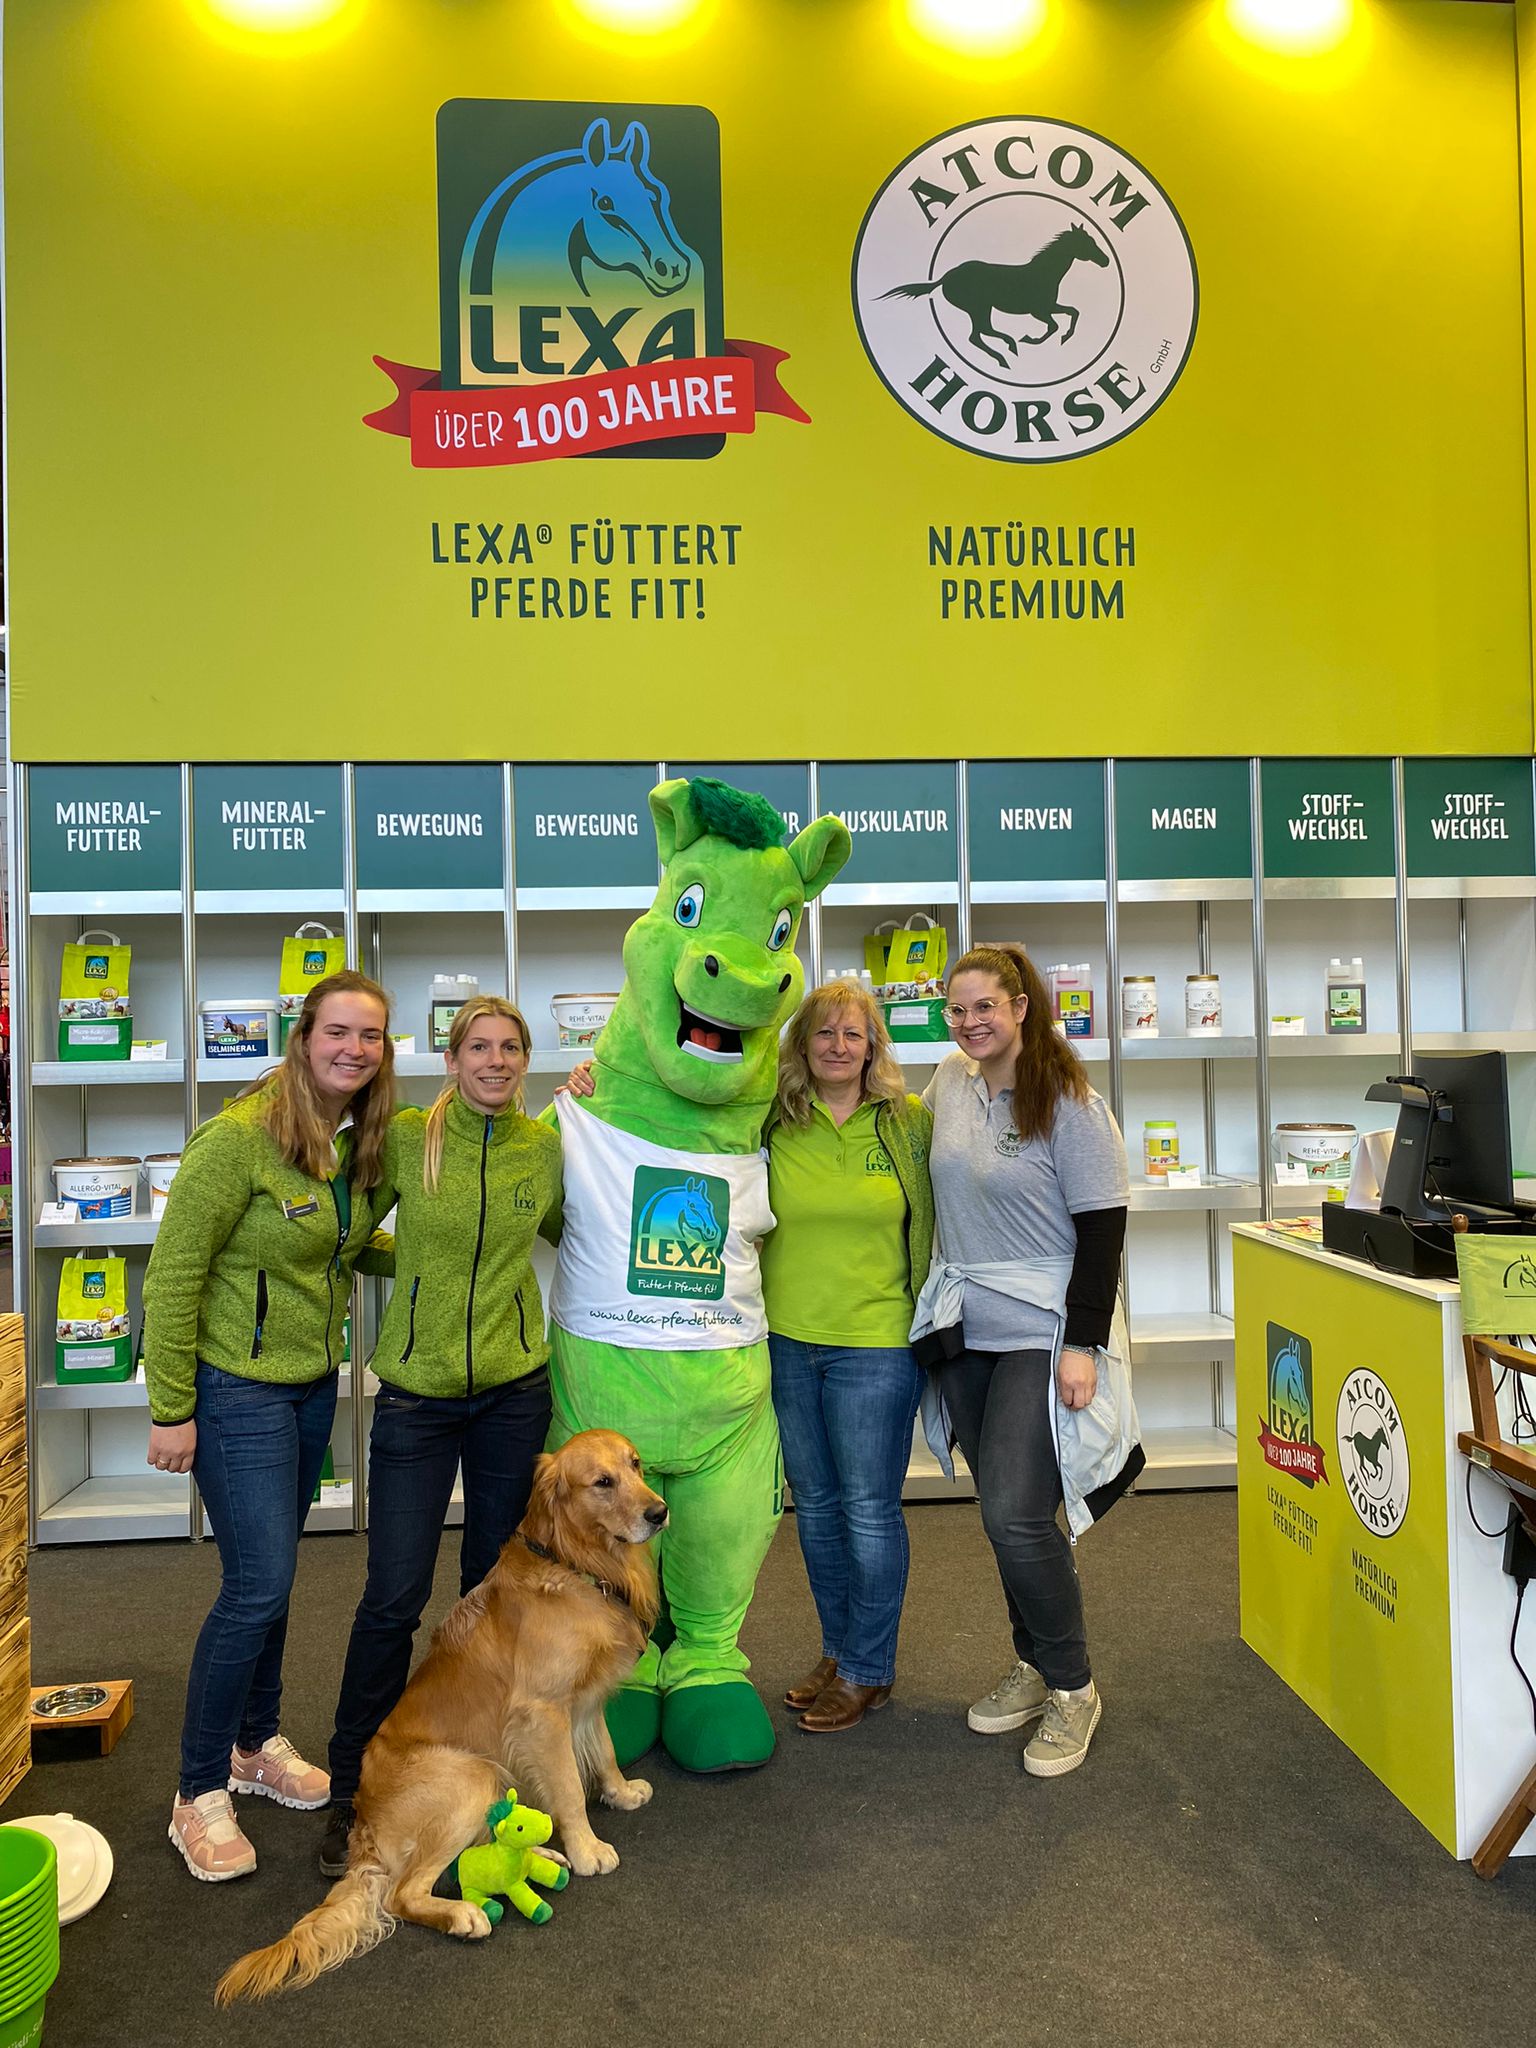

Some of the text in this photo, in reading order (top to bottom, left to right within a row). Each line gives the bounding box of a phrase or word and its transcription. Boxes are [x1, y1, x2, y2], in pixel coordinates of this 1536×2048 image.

[907, 135, 1152, 233] ATCOM
[469, 304, 696, 376] LEXA
[1149, 338, 1173, 375] GmbH
[434, 373, 737, 450] ÜBER 100 JAHRE
[907, 354, 1147, 443] HORSE
[571, 518, 743, 566] FÜTTERT
[928, 520, 1136, 568] NATÜRLICH
[471, 577, 706, 620] PFERDE FIT!
[941, 579, 1125, 620] PREMIUM
[56, 801, 162, 825] MINERAL-
[221, 800, 326, 824] MINERAL-
[1301, 793, 1364, 816] STOFF-
[1443, 793, 1505, 816] STOFF-
[376, 813, 483, 837] BEWEGUNG
[535, 813, 639, 837] BEWEGUNG
[999, 807, 1073, 831] NERVEN
[1151, 807, 1217, 830] MAGEN
[1287, 818, 1369, 841] WECHSEL
[1430, 817, 1510, 840] WECHSEL
[66, 827, 142, 852] FUTTER
[232, 827, 307, 851] FUTTER
[1302, 1147, 1341, 1155] REHE-VITAL
[866, 1163, 891, 1172] LEXA
[70, 1183, 122, 1193] ALLERGO-VITAL
[514, 1198, 536, 1211] LEXA
[639, 1237, 718, 1270] LEXA
[674, 1281, 703, 1294] Pferde
[1345, 1376, 1399, 1435] ATCOM
[1272, 1403, 1309, 1445] LEXA
[1279, 1447, 1292, 1467] 100
[1292, 1448, 1317, 1474] JAHRE
[1347, 1471, 1399, 1529] HORSE
[1288, 1499, 1318, 1538] FÜTTERT
[1273, 1509, 1313, 1556] PFERDE FIT!
[1351, 1546, 1398, 1601] NATÜRLICH
[1354, 1573, 1396, 1624] PREMIUM
